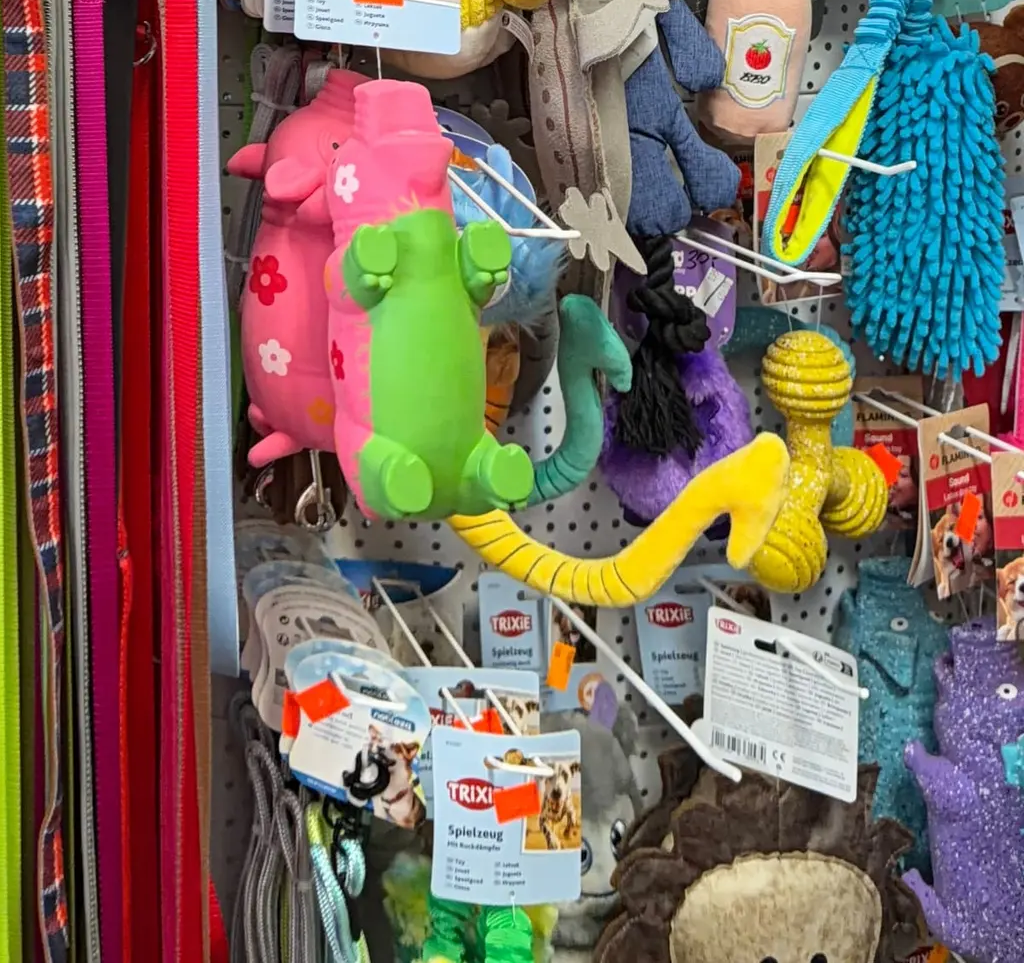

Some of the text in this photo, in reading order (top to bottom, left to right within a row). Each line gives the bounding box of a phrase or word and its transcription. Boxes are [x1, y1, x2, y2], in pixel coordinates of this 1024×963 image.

[856, 411, 912, 422] FLAMINO
[492, 647, 533, 658] Spielzeug
[651, 650, 699, 662] Spielzeug
[448, 825, 504, 842] Spielzeug
